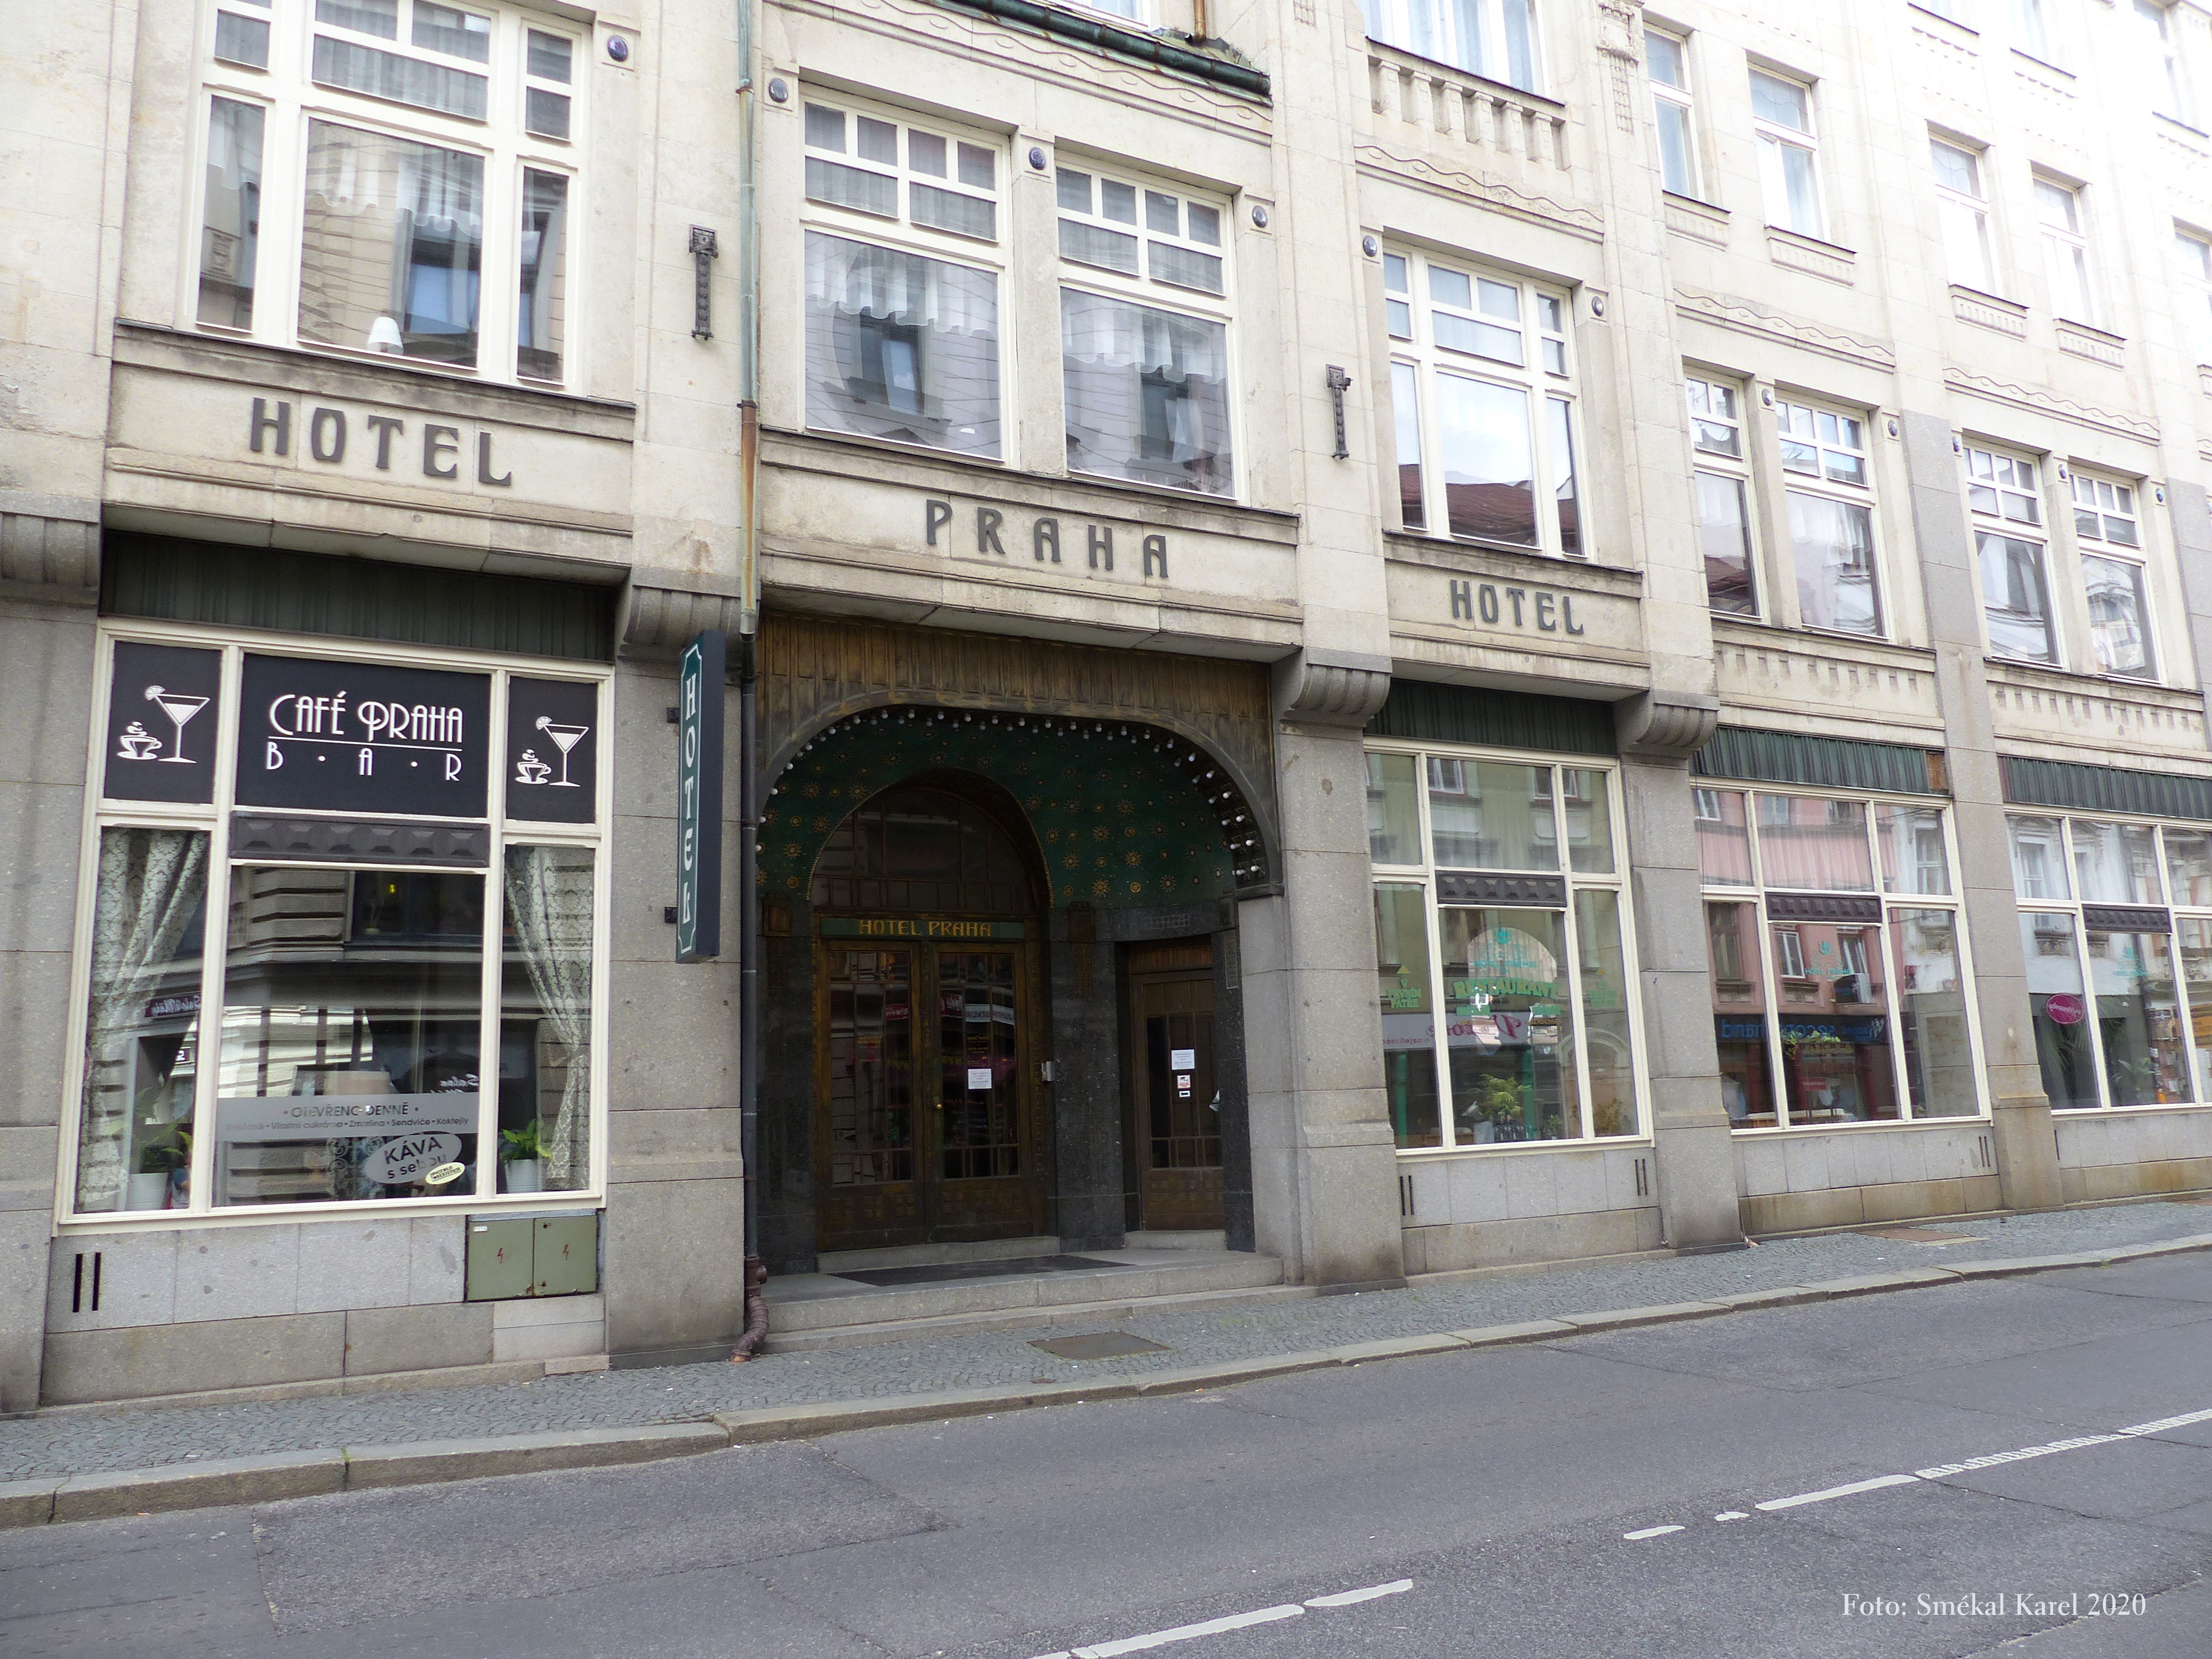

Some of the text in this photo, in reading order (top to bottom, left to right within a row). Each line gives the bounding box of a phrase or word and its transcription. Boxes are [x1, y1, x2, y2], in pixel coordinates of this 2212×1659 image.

[251, 398, 512, 486] HOTEL
[927, 499, 1168, 577] PRAHA
[1450, 580, 1584, 635] HOTEL
[269, 690, 463, 742] CAFÉ PRAHA
[682, 672, 697, 925] HOTEL
[859, 919, 992, 937] HOTEL PRAHA
[1453, 978, 1559, 999] RESTAURANT
[291, 1101, 409, 1118] OTEVŘENO DENNĚ
[392, 1118, 430, 1126] Sendviče
[437, 1116, 469, 1126] Koktejly
[384, 1135, 443, 1165] KÁVA
[387, 1155, 448, 1180] s sebou
